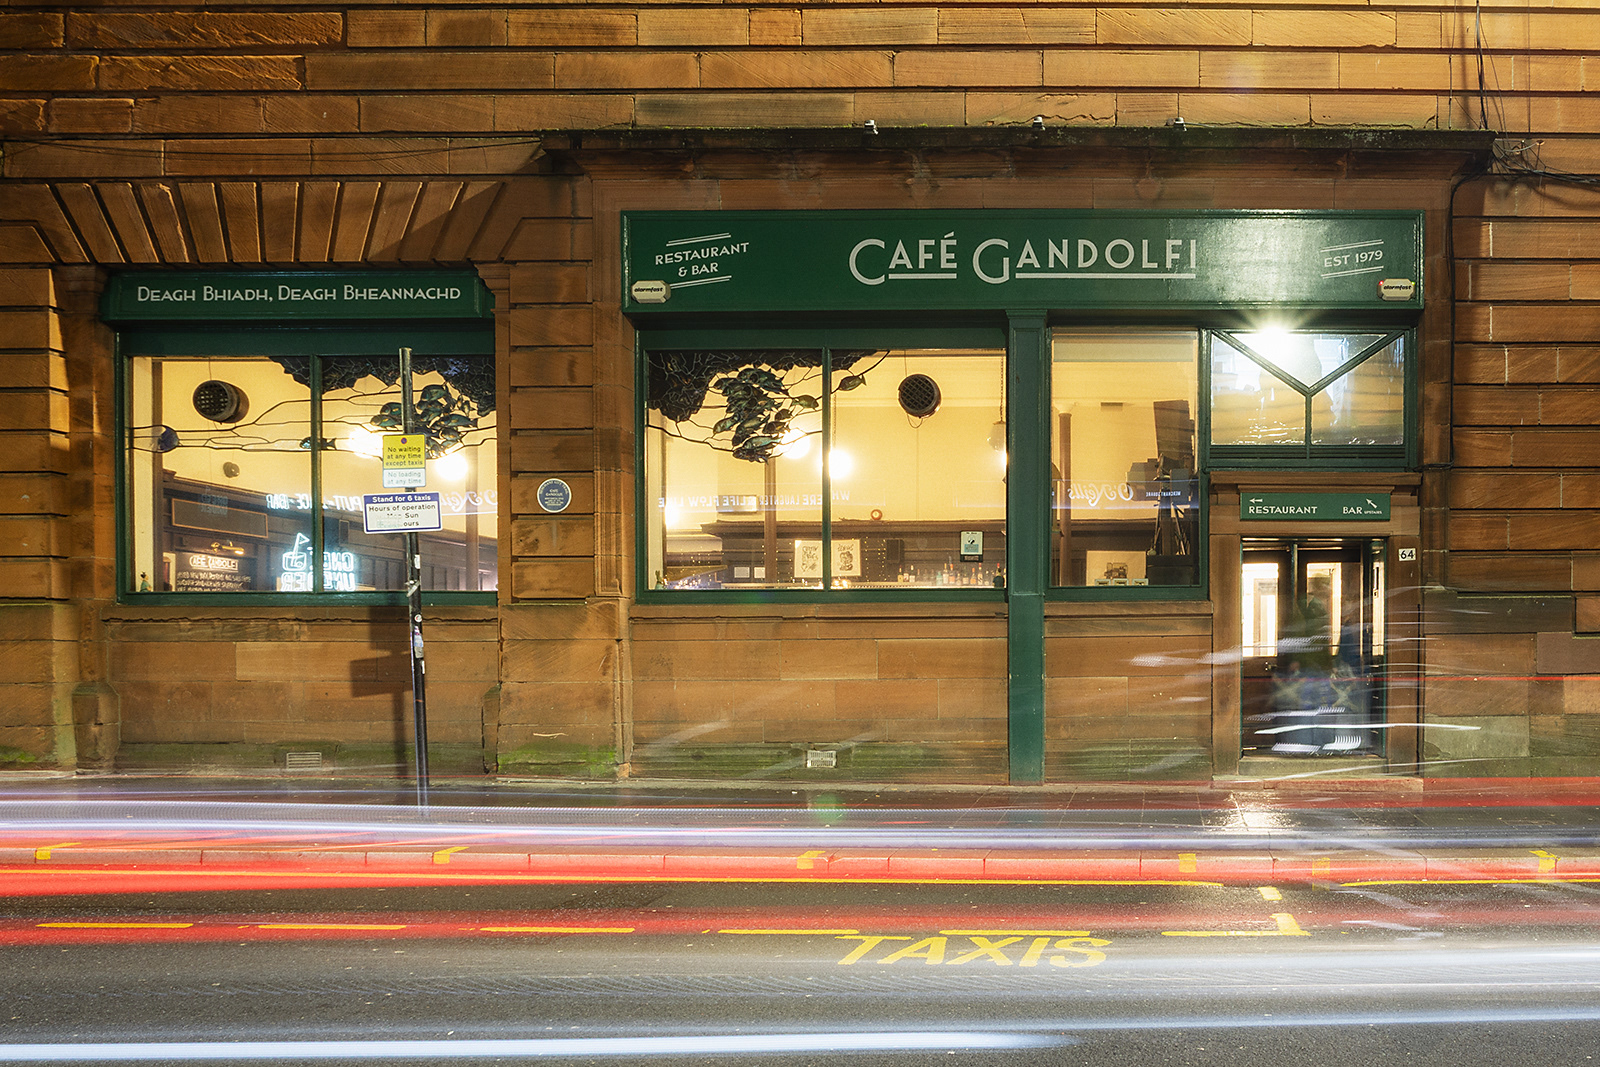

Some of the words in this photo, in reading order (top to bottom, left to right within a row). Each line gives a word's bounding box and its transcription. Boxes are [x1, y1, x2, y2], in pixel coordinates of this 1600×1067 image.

[655, 242, 750, 265] RESTAURANT
[849, 231, 958, 285] CAFÉ
[972, 238, 1197, 285] GANDOLFI
[1324, 254, 1351, 267] EST
[1355, 250, 1383, 263] 1979
[678, 266, 688, 277] &
[691, 262, 719, 275] BAR
[137, 286, 196, 302] DEAGH
[203, 285, 273, 303] BHIADH,
[277, 285, 336, 301] DEAGH
[343, 284, 461, 300] BHEANNACHD
[401, 503, 436, 511] operation
[1248, 506, 1318, 514] RESTAURANT
[1342, 506, 1363, 515] BAR
[1400, 550, 1414, 560] 64
[835, 935, 1112, 968] TAXIS
